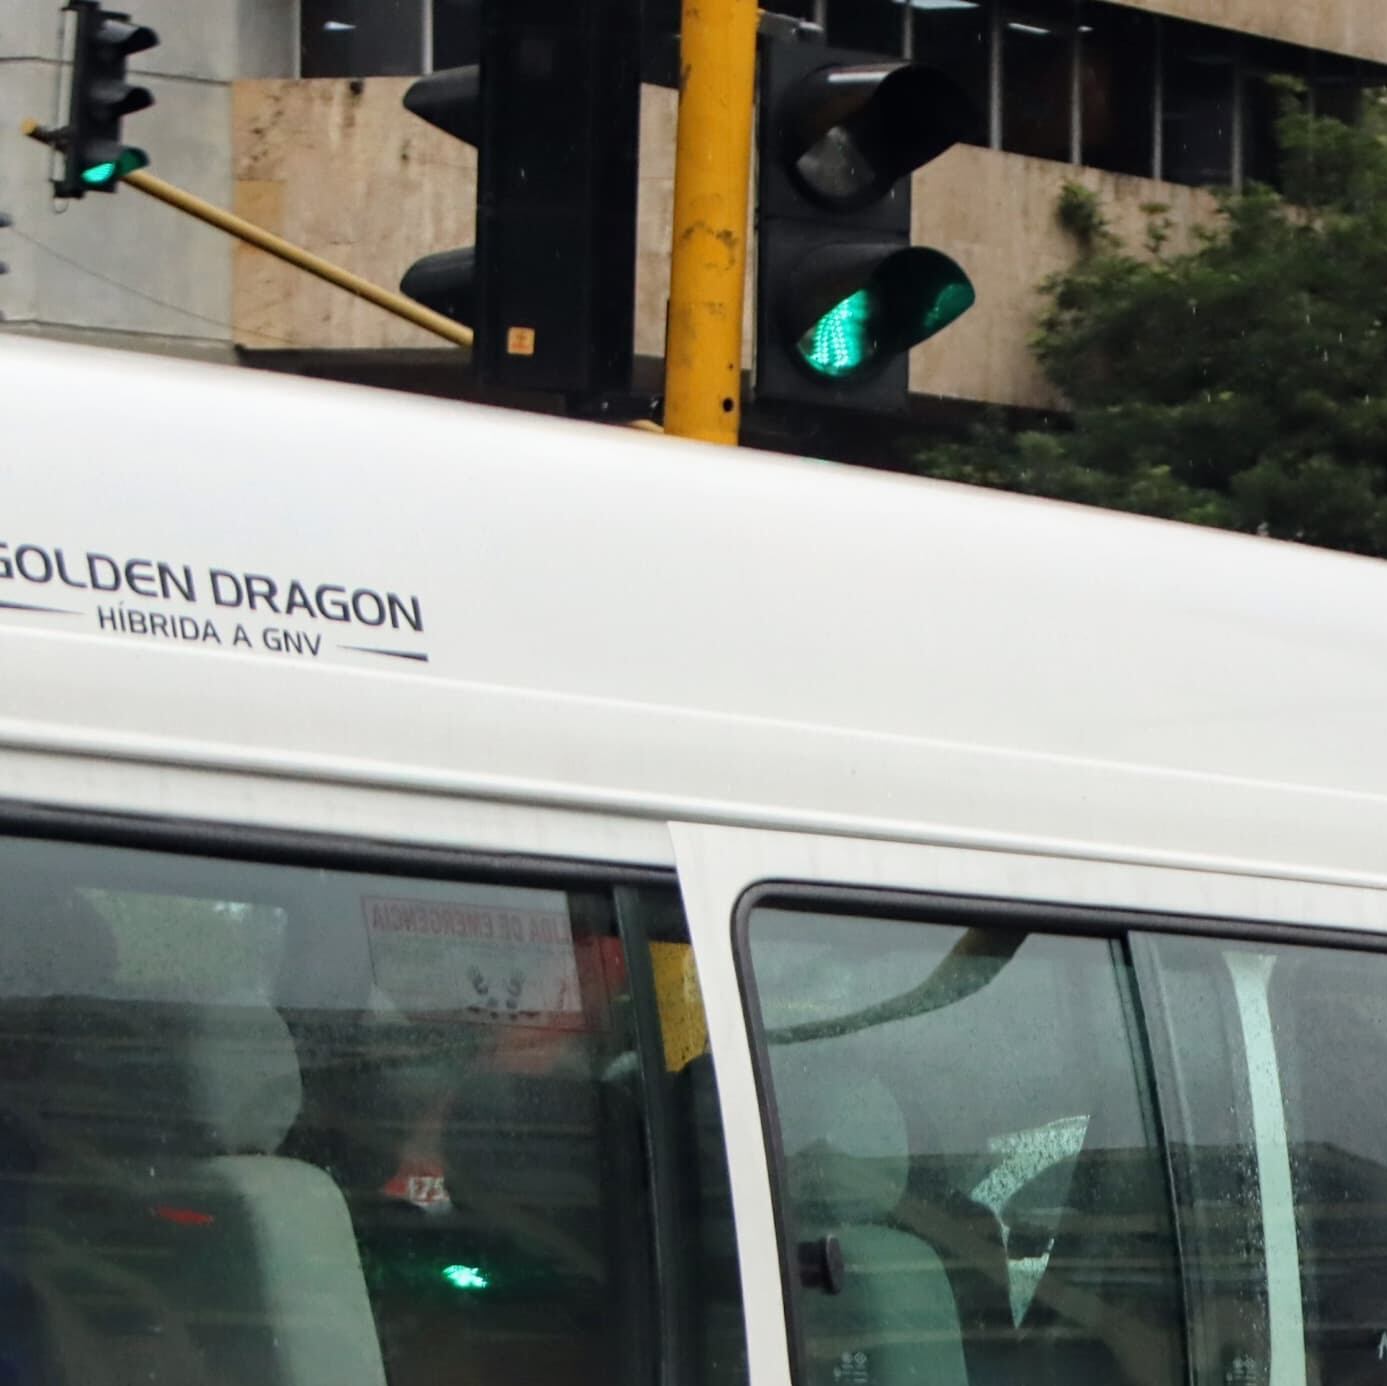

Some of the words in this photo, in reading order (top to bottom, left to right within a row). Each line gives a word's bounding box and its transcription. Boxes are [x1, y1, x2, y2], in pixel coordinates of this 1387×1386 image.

[98, 601, 221, 644] HÍBRIDA
[232, 623, 254, 648] A
[263, 627, 322, 657] GNV
[209, 568, 424, 632] DRAGON
